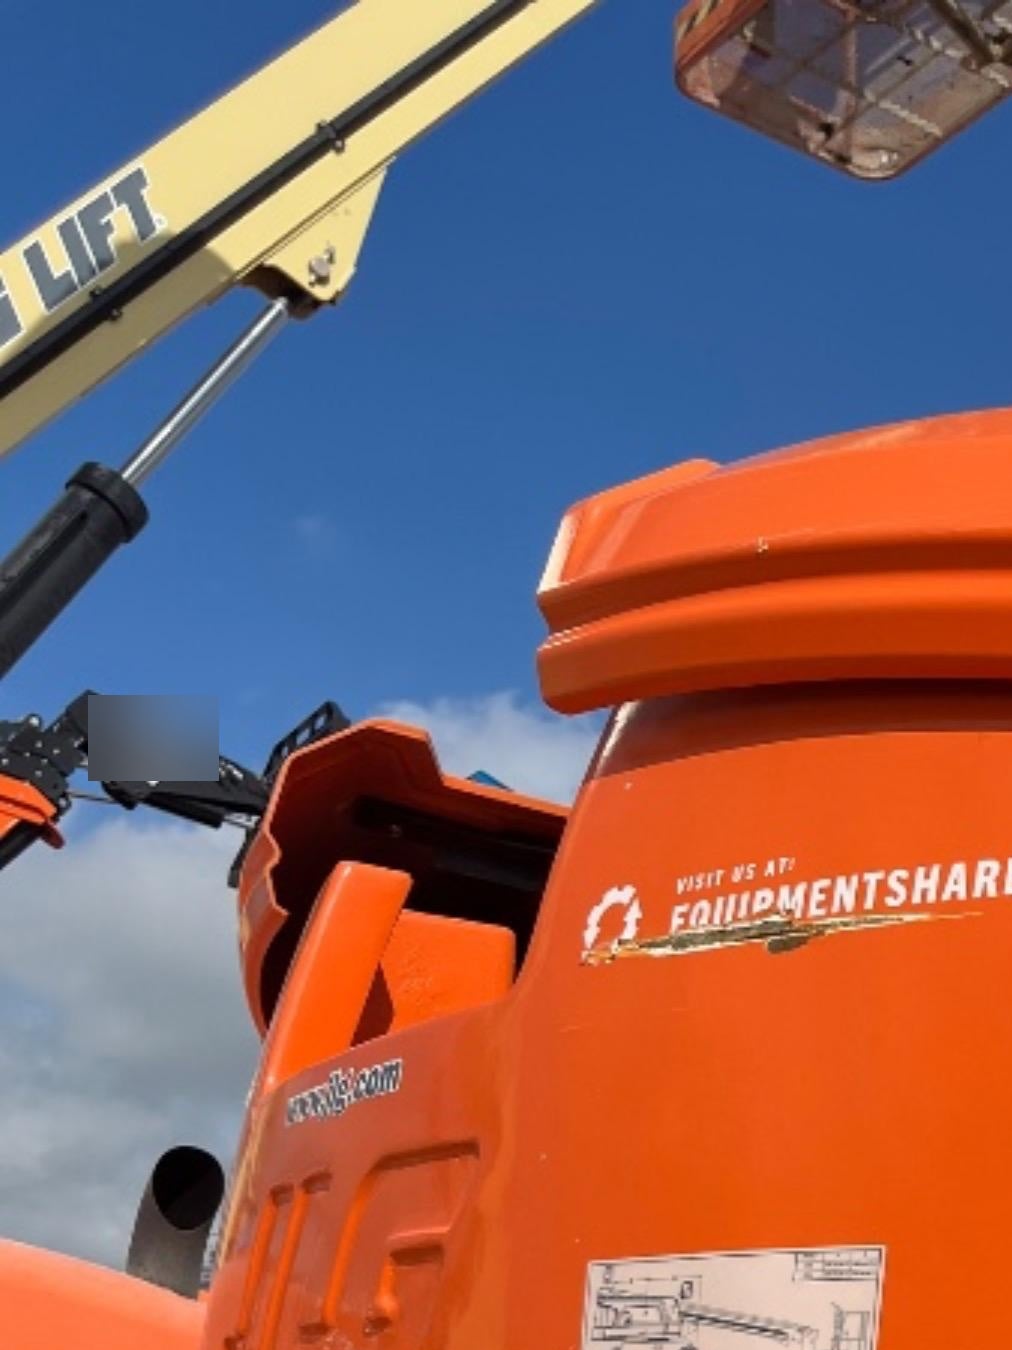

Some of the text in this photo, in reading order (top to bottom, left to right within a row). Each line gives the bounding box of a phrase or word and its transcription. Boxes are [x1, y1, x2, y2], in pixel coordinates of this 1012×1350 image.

[21, 164, 159, 316] LIFT
[675, 869, 726, 896] VISIT
[730, 862, 758, 884] US
